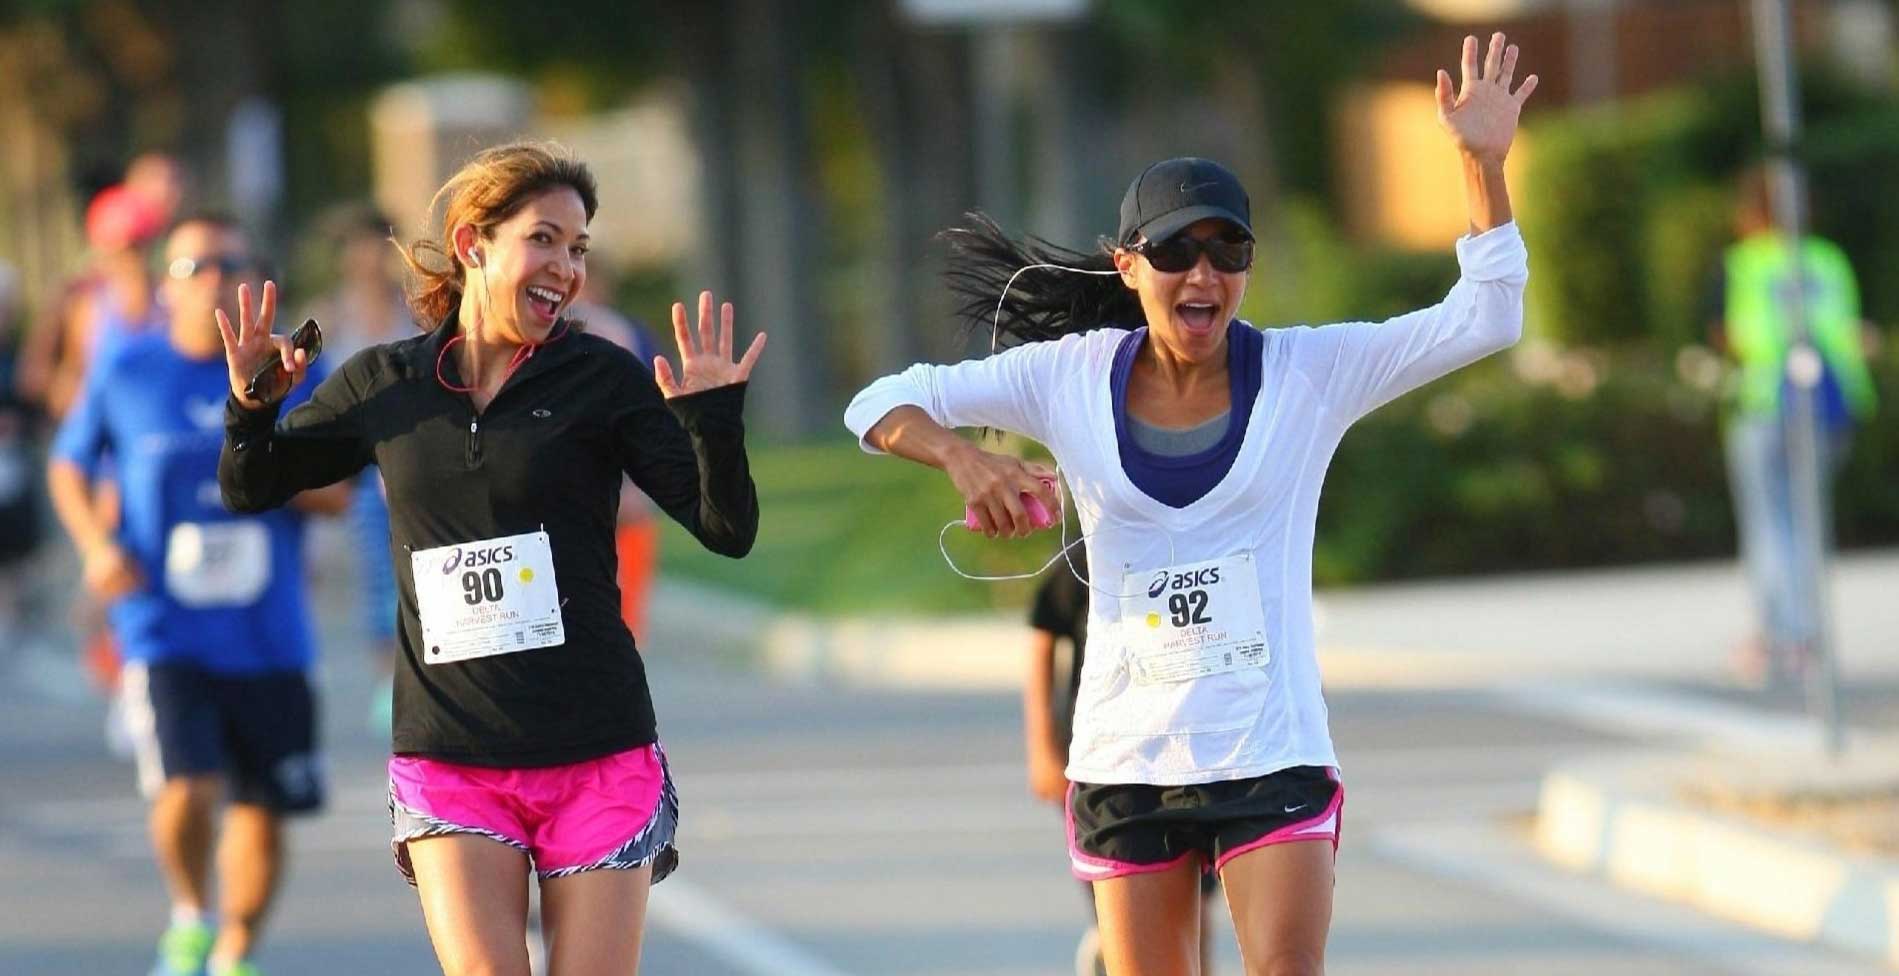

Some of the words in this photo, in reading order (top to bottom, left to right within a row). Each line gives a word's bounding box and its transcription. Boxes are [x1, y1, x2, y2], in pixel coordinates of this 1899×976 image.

[462, 568, 504, 605] 90
[1168, 589, 1212, 628] 92
[1180, 626, 1208, 638] DELTA
[1207, 631, 1227, 642] RUN
